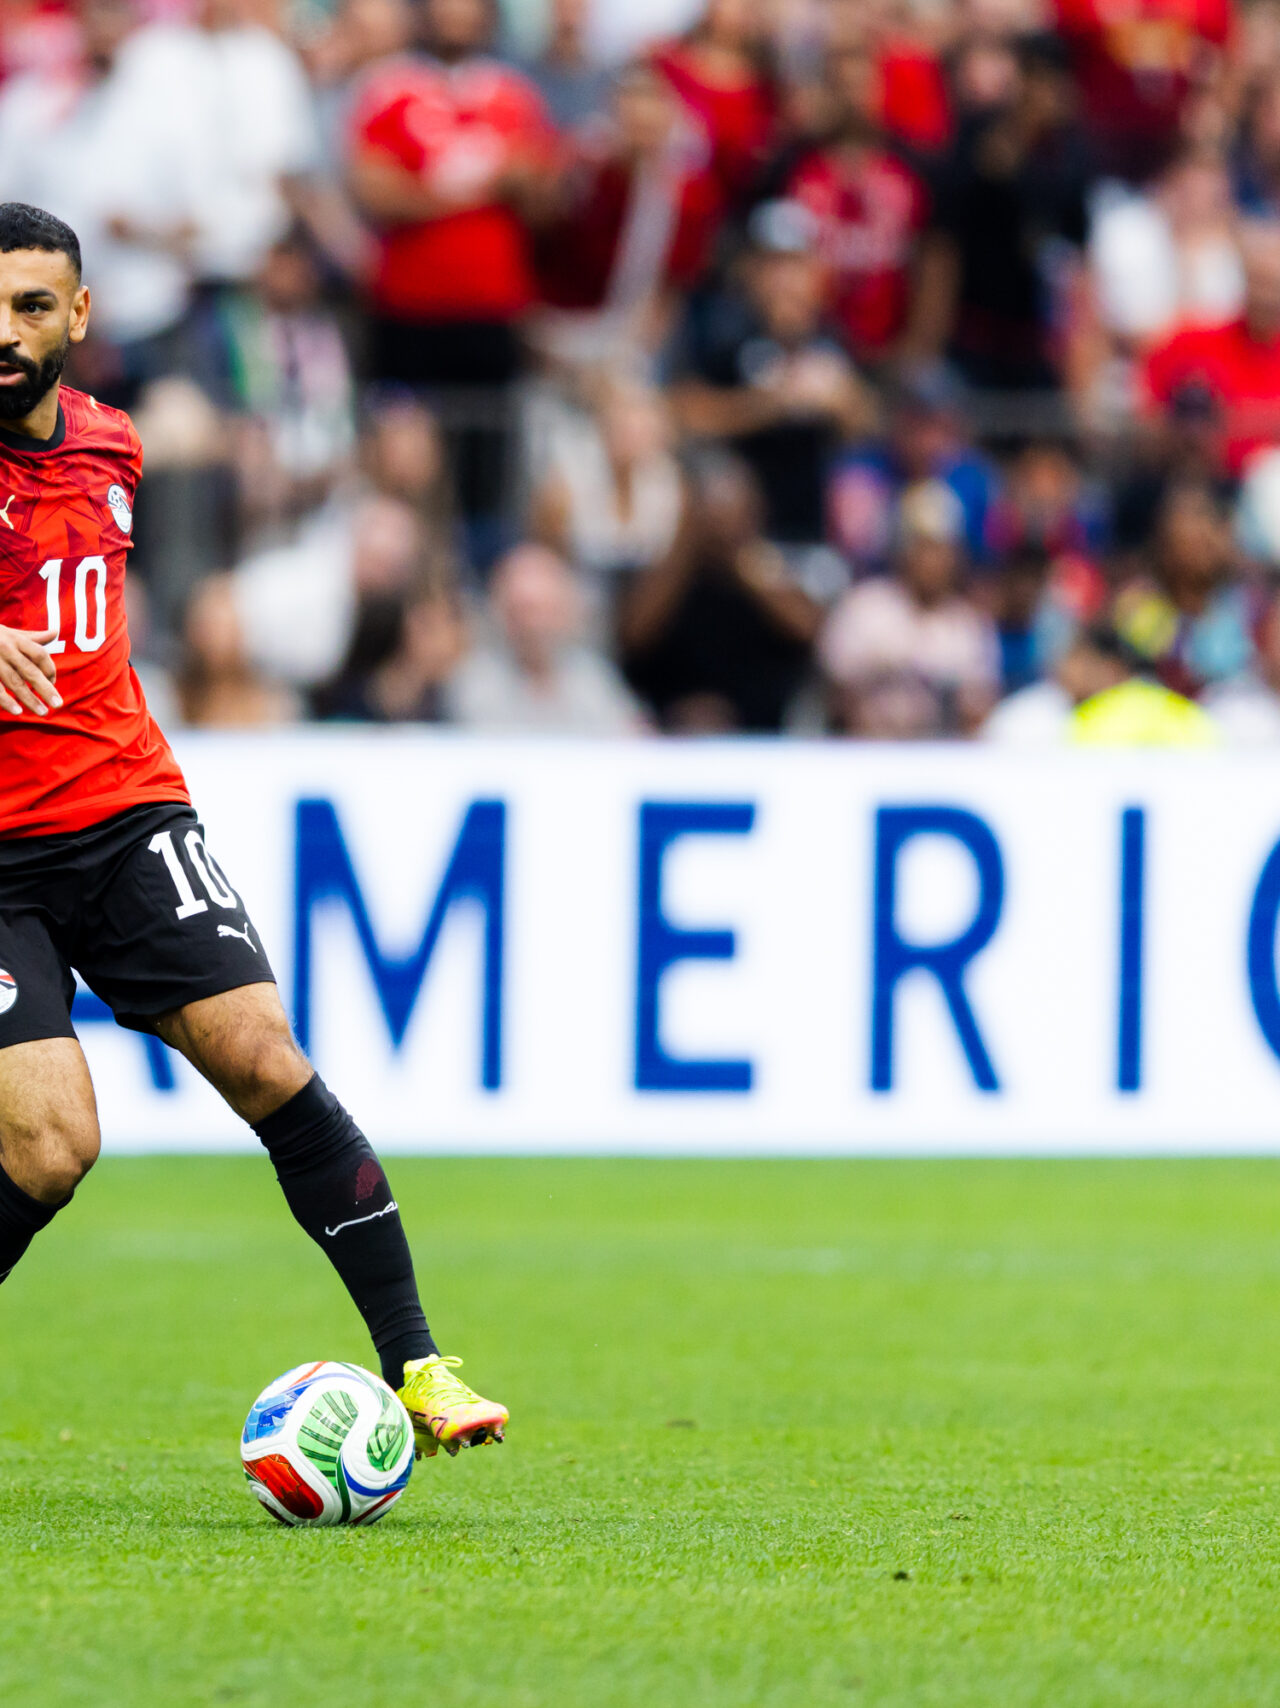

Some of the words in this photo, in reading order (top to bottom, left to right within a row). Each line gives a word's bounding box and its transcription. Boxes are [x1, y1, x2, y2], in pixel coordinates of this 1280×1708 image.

[38, 555, 107, 654] 10
[147, 829, 238, 920] 10
[70, 797, 1280, 1092] MERI
